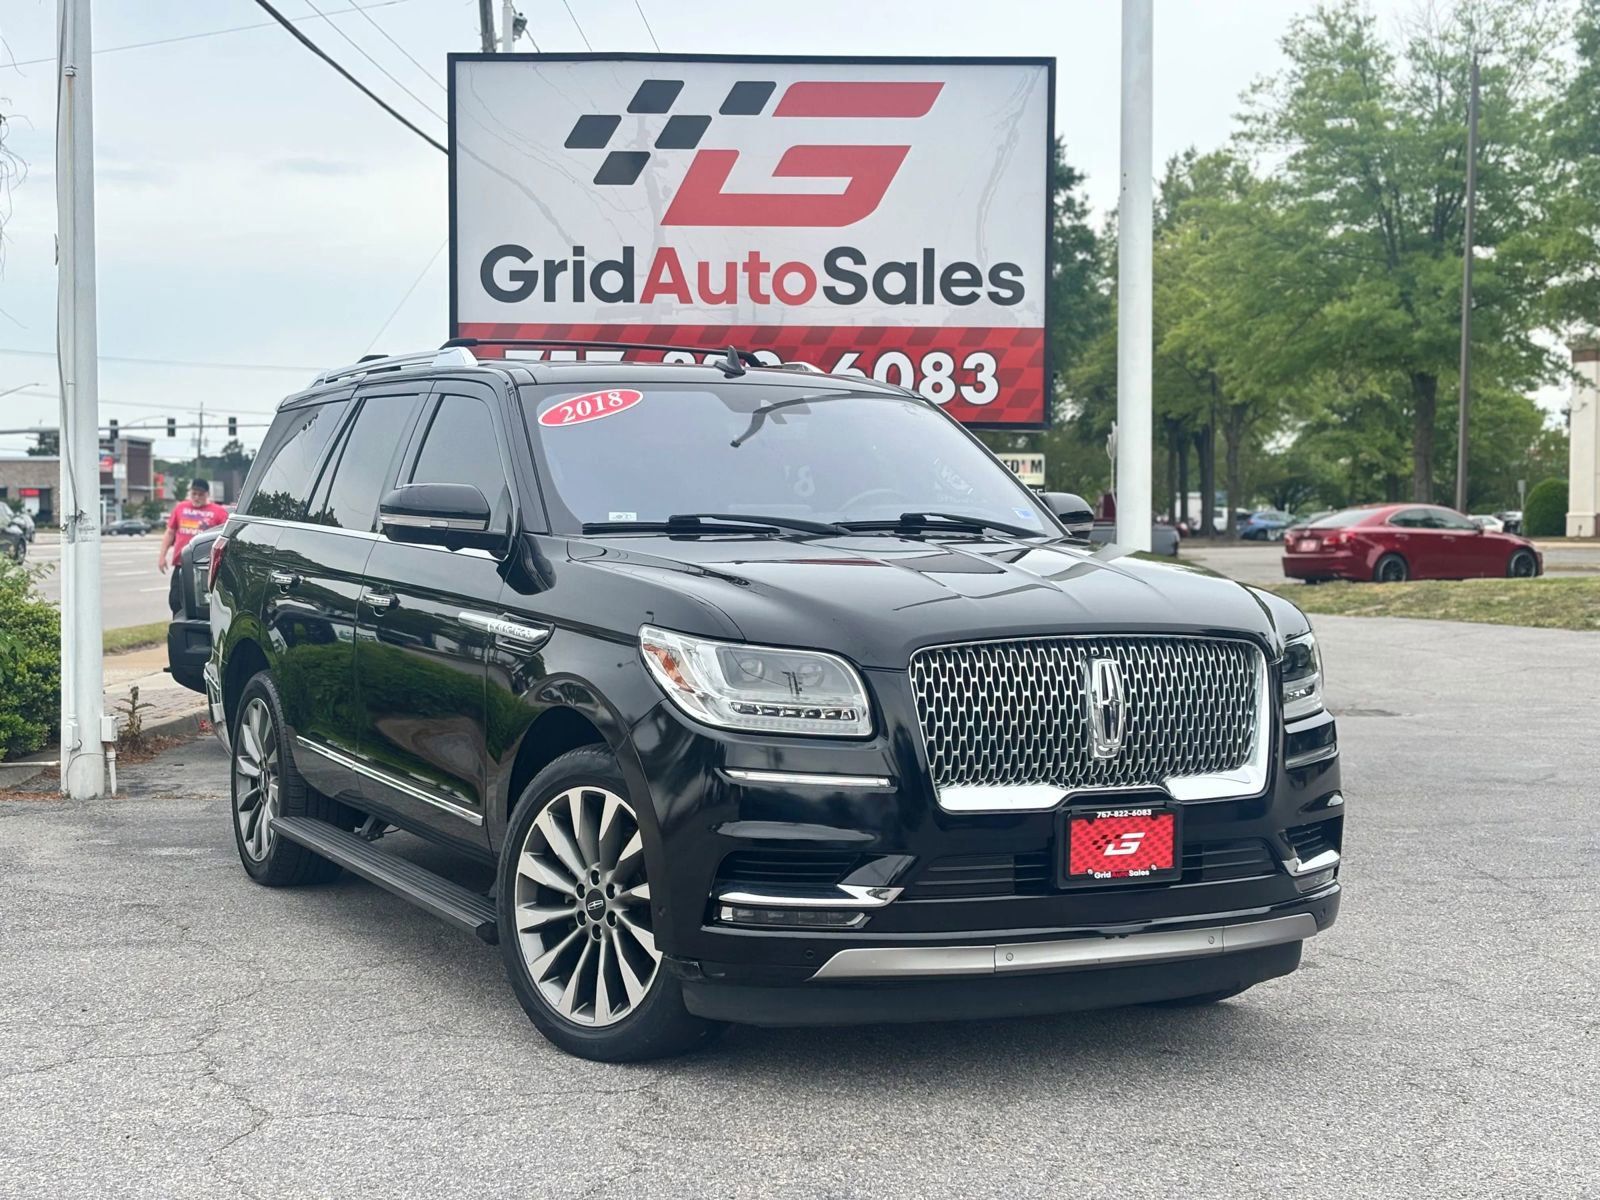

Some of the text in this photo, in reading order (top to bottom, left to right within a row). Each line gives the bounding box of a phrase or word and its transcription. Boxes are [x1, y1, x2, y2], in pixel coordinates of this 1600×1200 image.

[479, 243, 1026, 306] GridAutoSales
[559, 390, 624, 423] 2018
[1097, 809, 1152, 818] 757-822-6083
